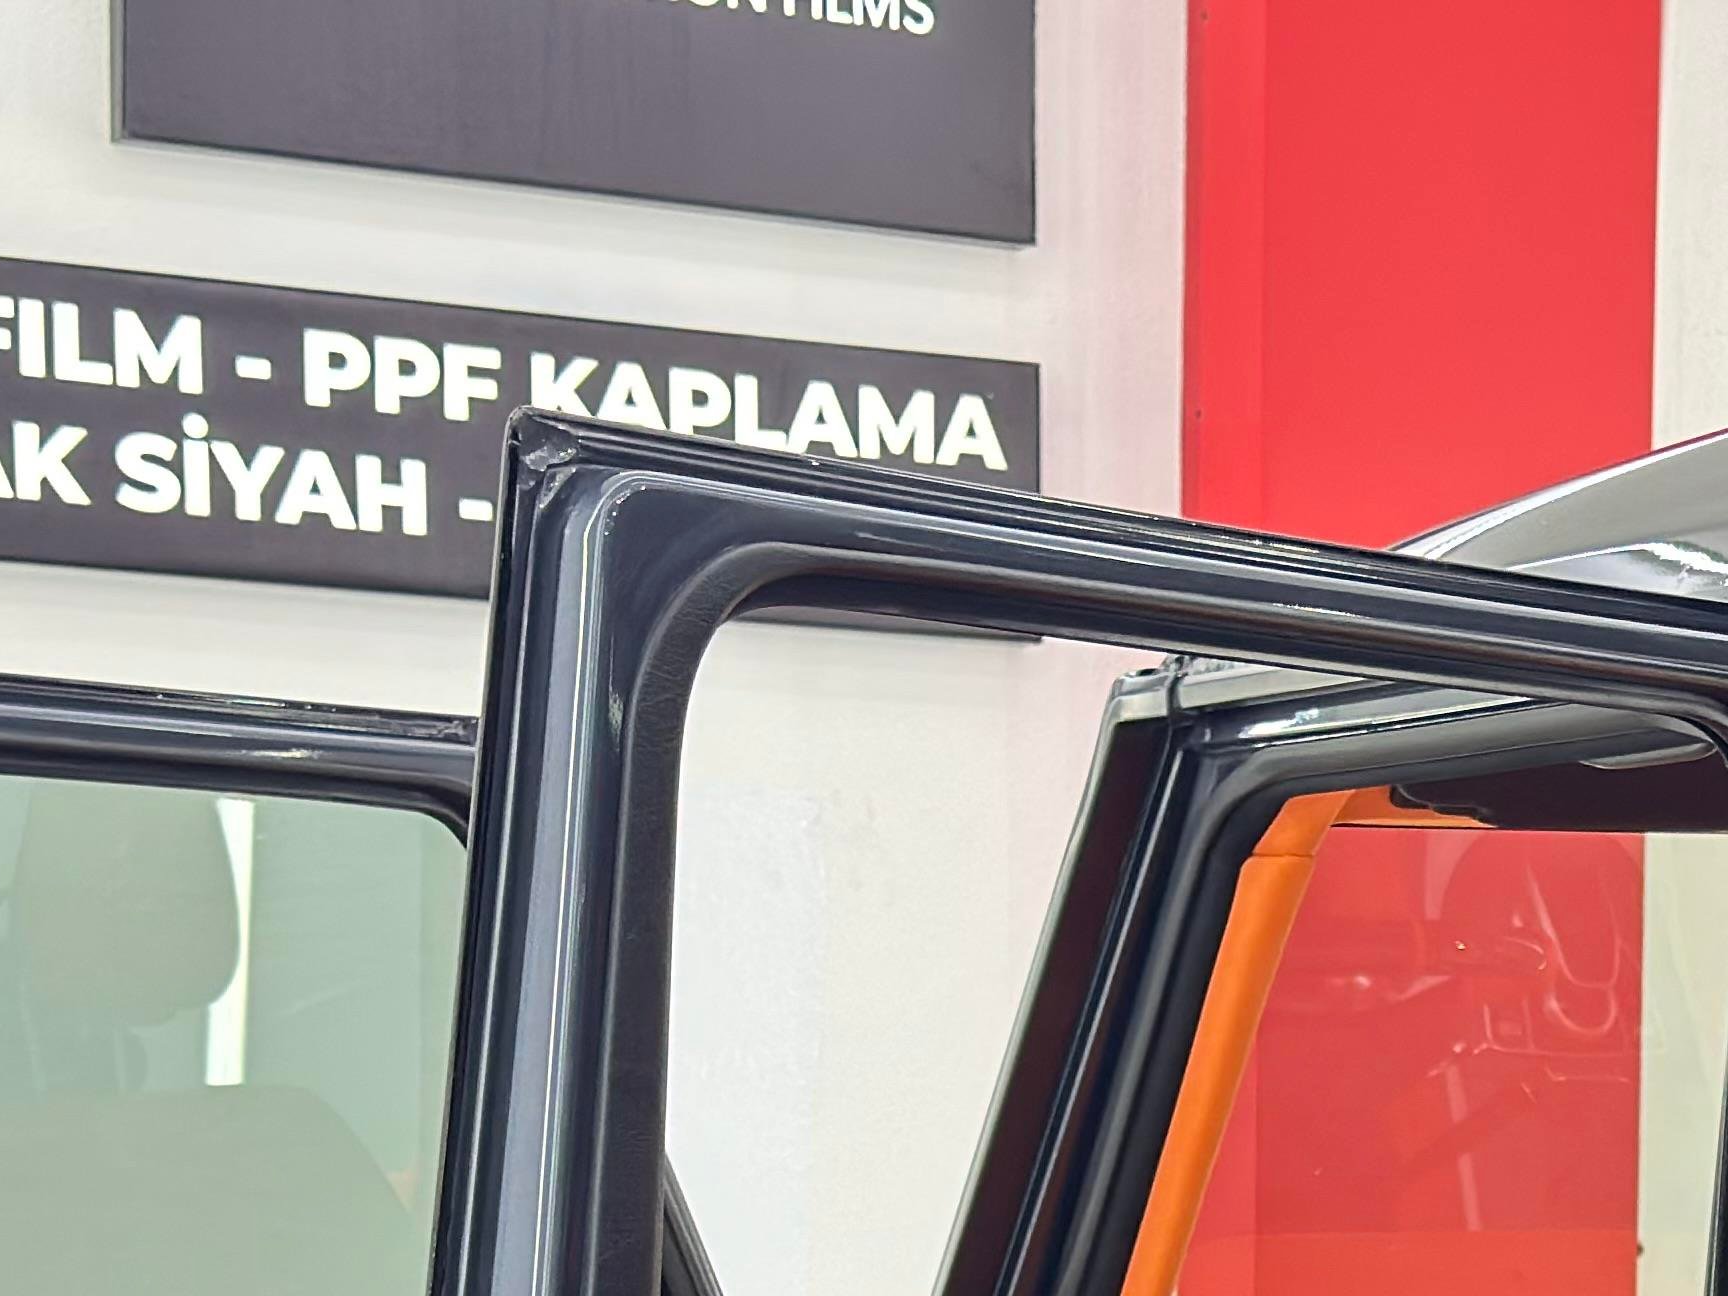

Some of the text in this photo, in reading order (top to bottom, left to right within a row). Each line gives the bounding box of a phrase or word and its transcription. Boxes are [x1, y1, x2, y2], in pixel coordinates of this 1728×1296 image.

[235, 356, 272, 380] -
[303, 328, 501, 422] PPF
[520, 352, 1008, 471] KAPLAMA
[115, 413, 427, 536] SİYAH
